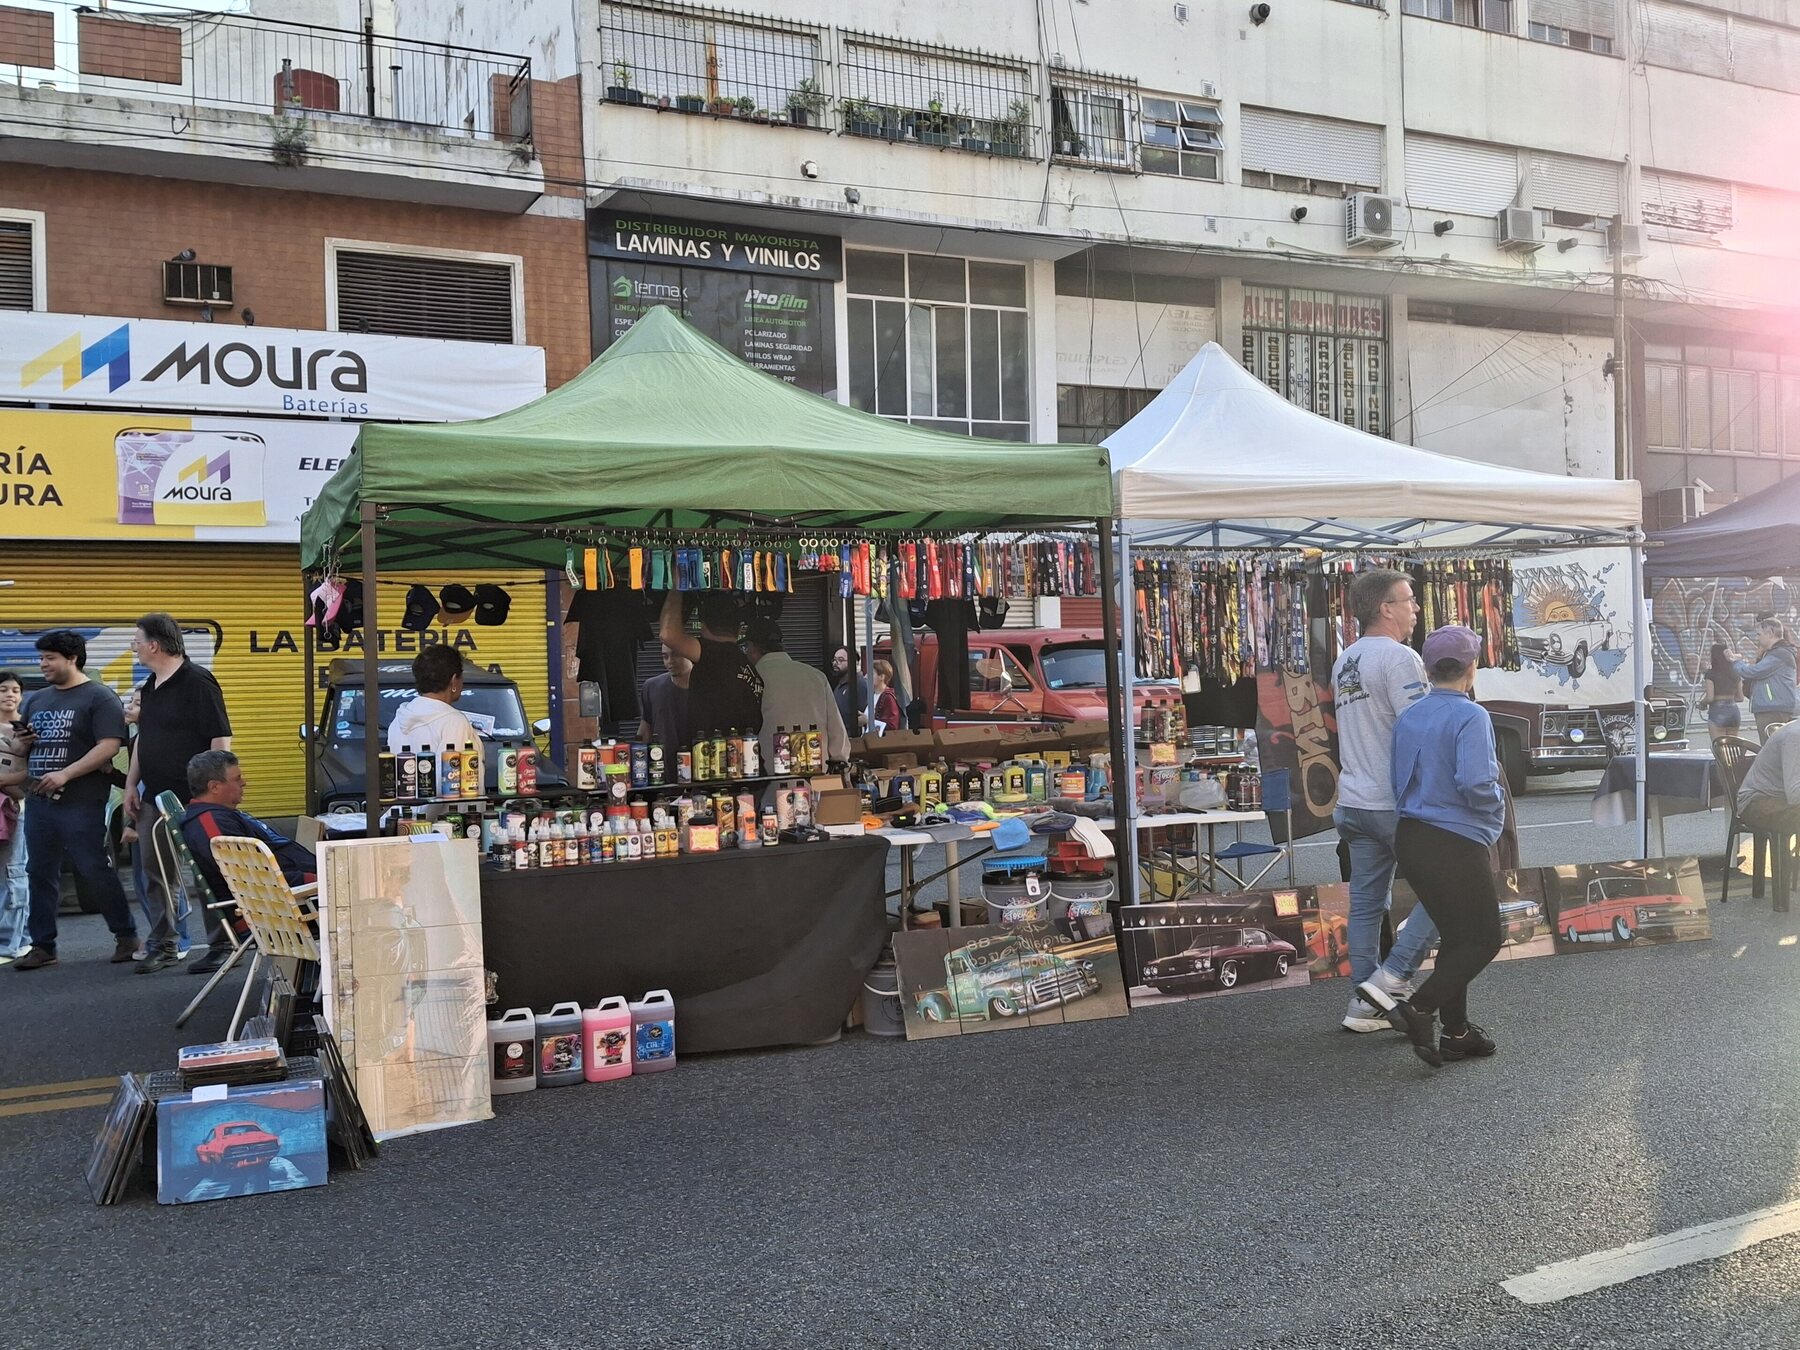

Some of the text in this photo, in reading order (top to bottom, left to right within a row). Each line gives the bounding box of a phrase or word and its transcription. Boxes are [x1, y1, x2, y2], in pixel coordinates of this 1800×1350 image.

[616, 219, 819, 249] DISTRIBUIDOR MAYORISTA
[616, 232, 821, 271] LAMINAS Y VINILOS
[775, 343, 812, 352] SEGURIDAD
[283, 394, 369, 415] Baterías
[250, 630, 299, 653] LA
